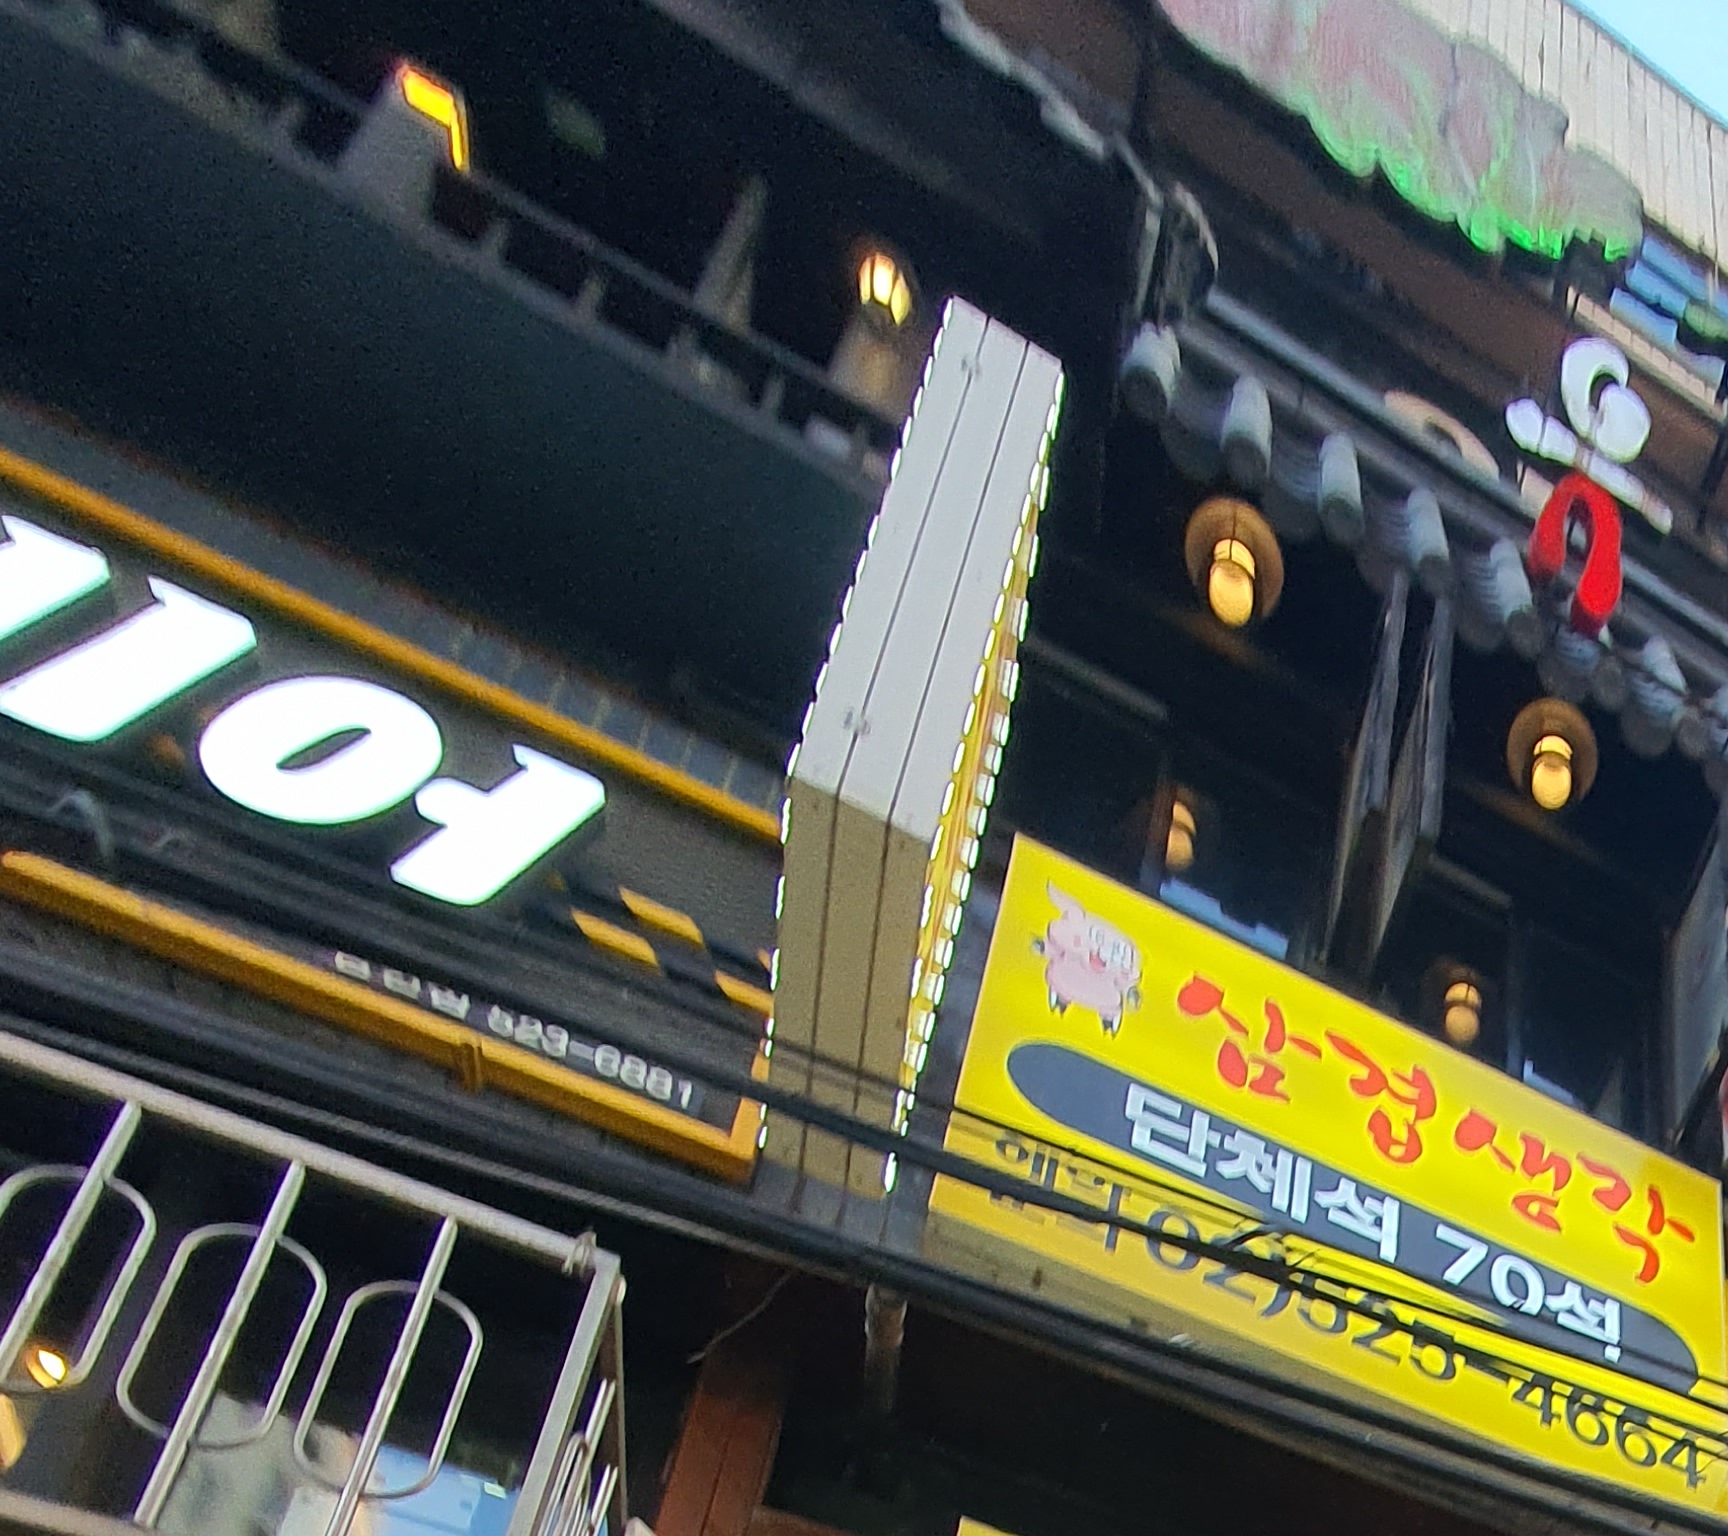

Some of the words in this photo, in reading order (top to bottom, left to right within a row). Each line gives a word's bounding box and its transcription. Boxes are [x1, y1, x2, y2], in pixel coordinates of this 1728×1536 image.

[1122, 1080, 1404, 1264] 단체석
[1432, 1222, 1626, 1362] 70석
[1177, 972, 1698, 1286] 삼겹생각
